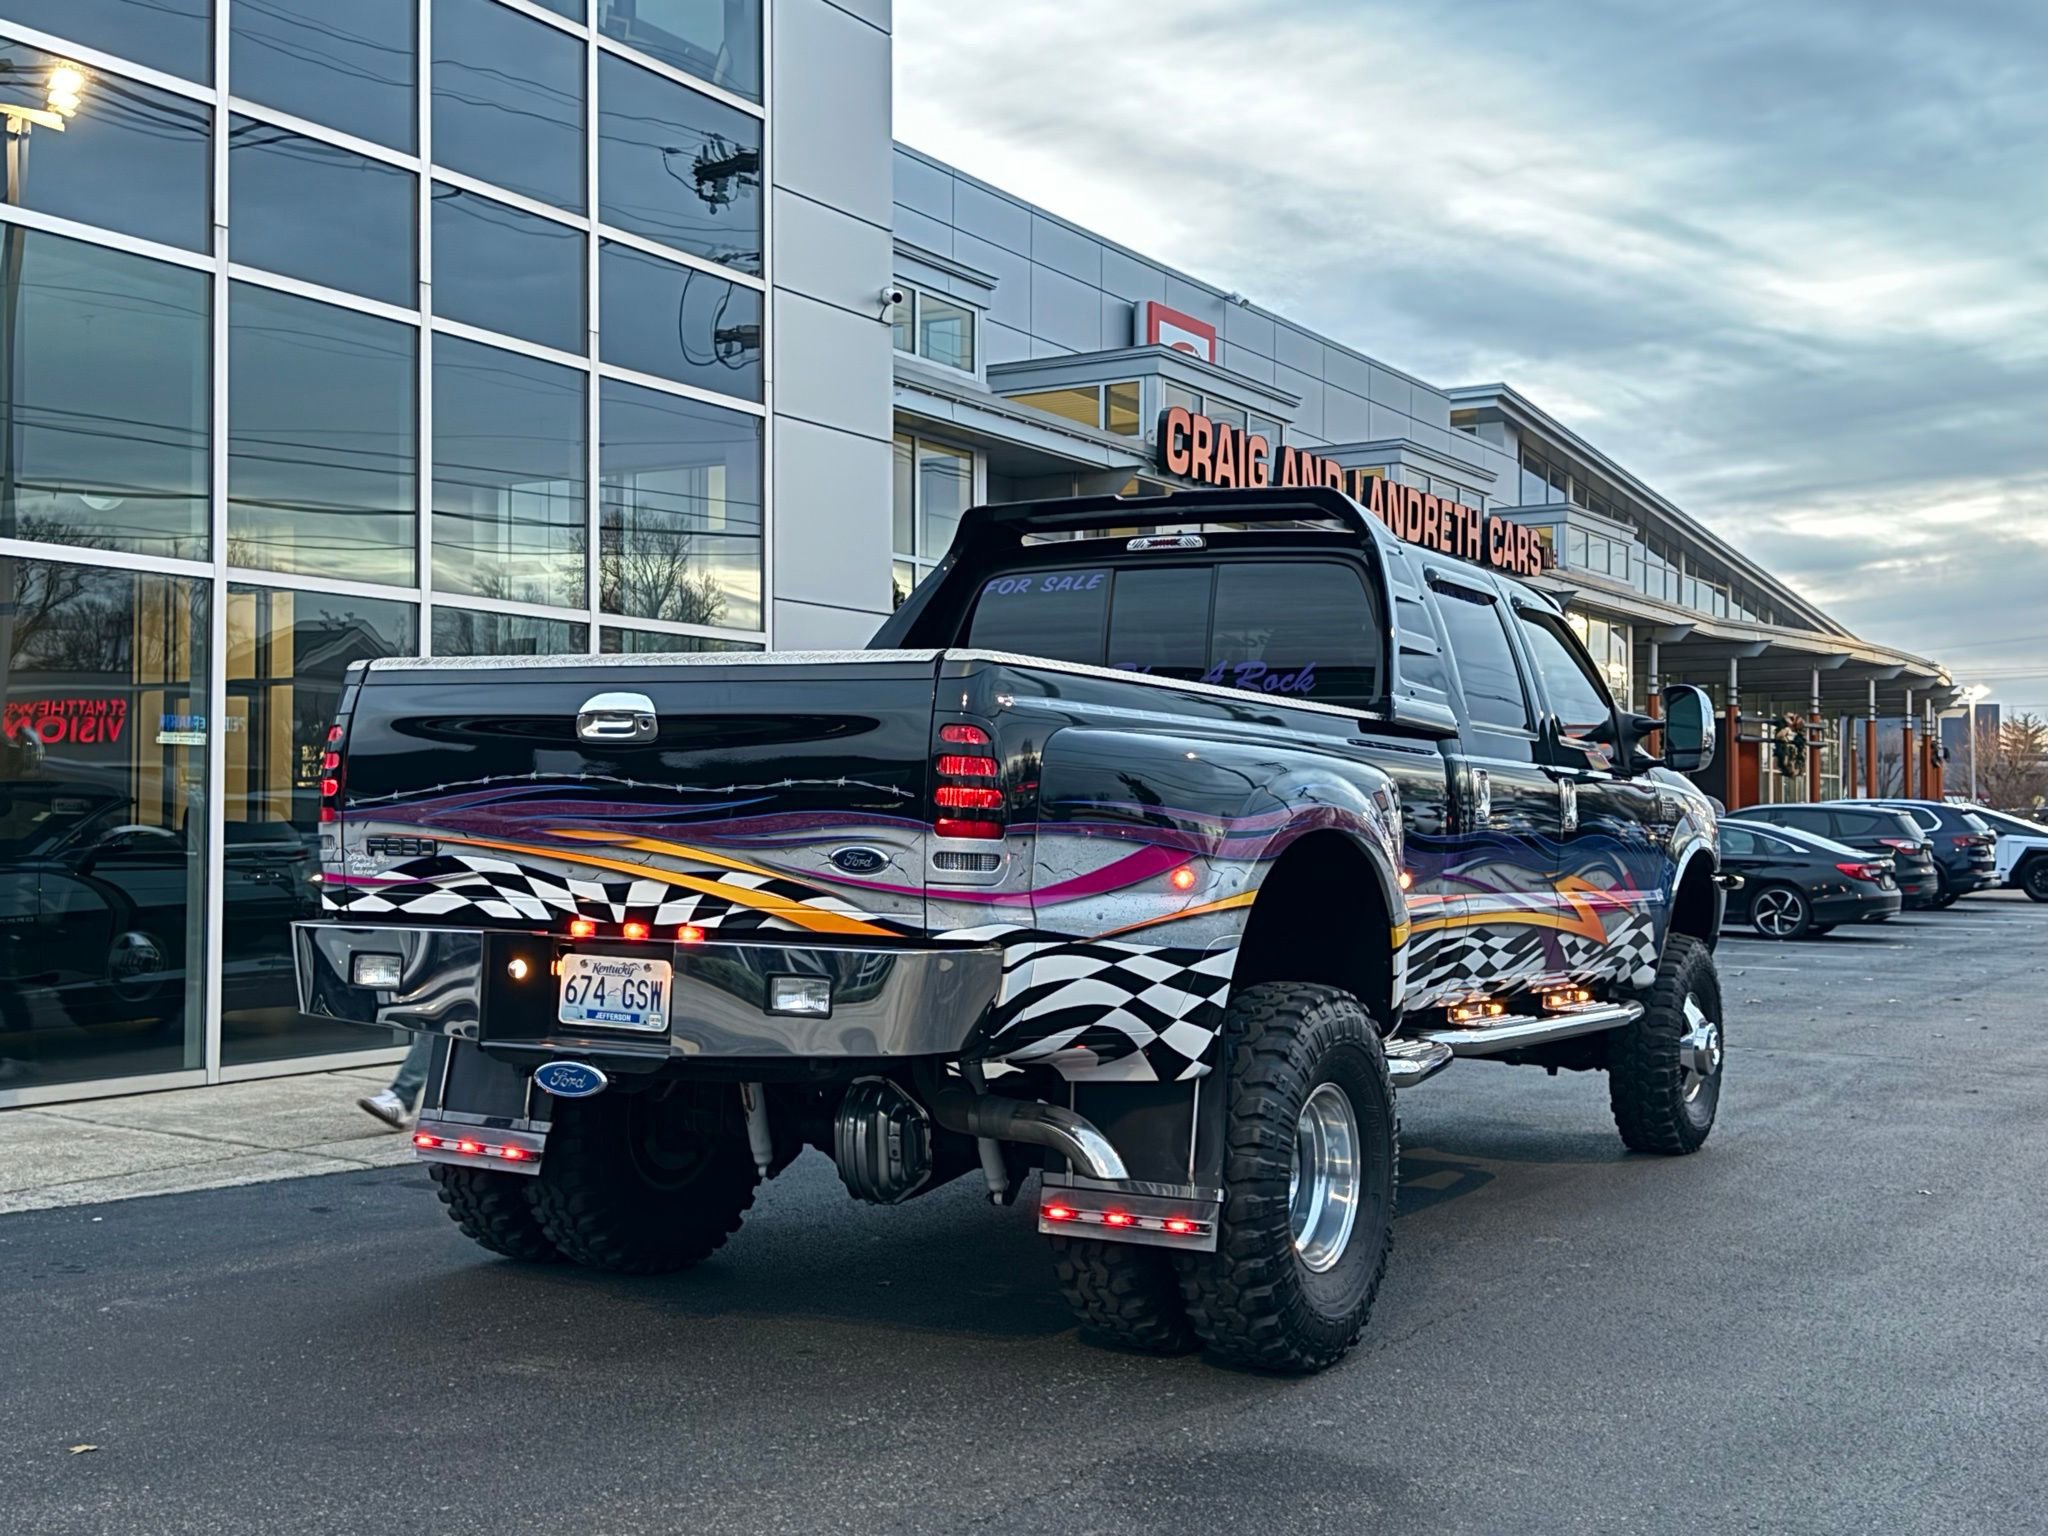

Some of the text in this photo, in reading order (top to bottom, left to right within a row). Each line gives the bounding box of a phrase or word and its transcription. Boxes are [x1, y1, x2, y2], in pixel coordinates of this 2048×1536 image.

[1165, 406, 1269, 488] CRAIG
[1282, 445, 1343, 491] AND
[1489, 515, 1542, 577] CARS
[982, 574, 1105, 595] FOR SALE
[1233, 661, 1317, 693] Rock
[843, 852, 873, 867] Ford
[592, 962, 635, 978] Kentucky
[564, 975, 663, 1012] 674 GSW
[595, 1011, 632, 1022] JEFFERSON
[550, 1067, 587, 1089] Ford
